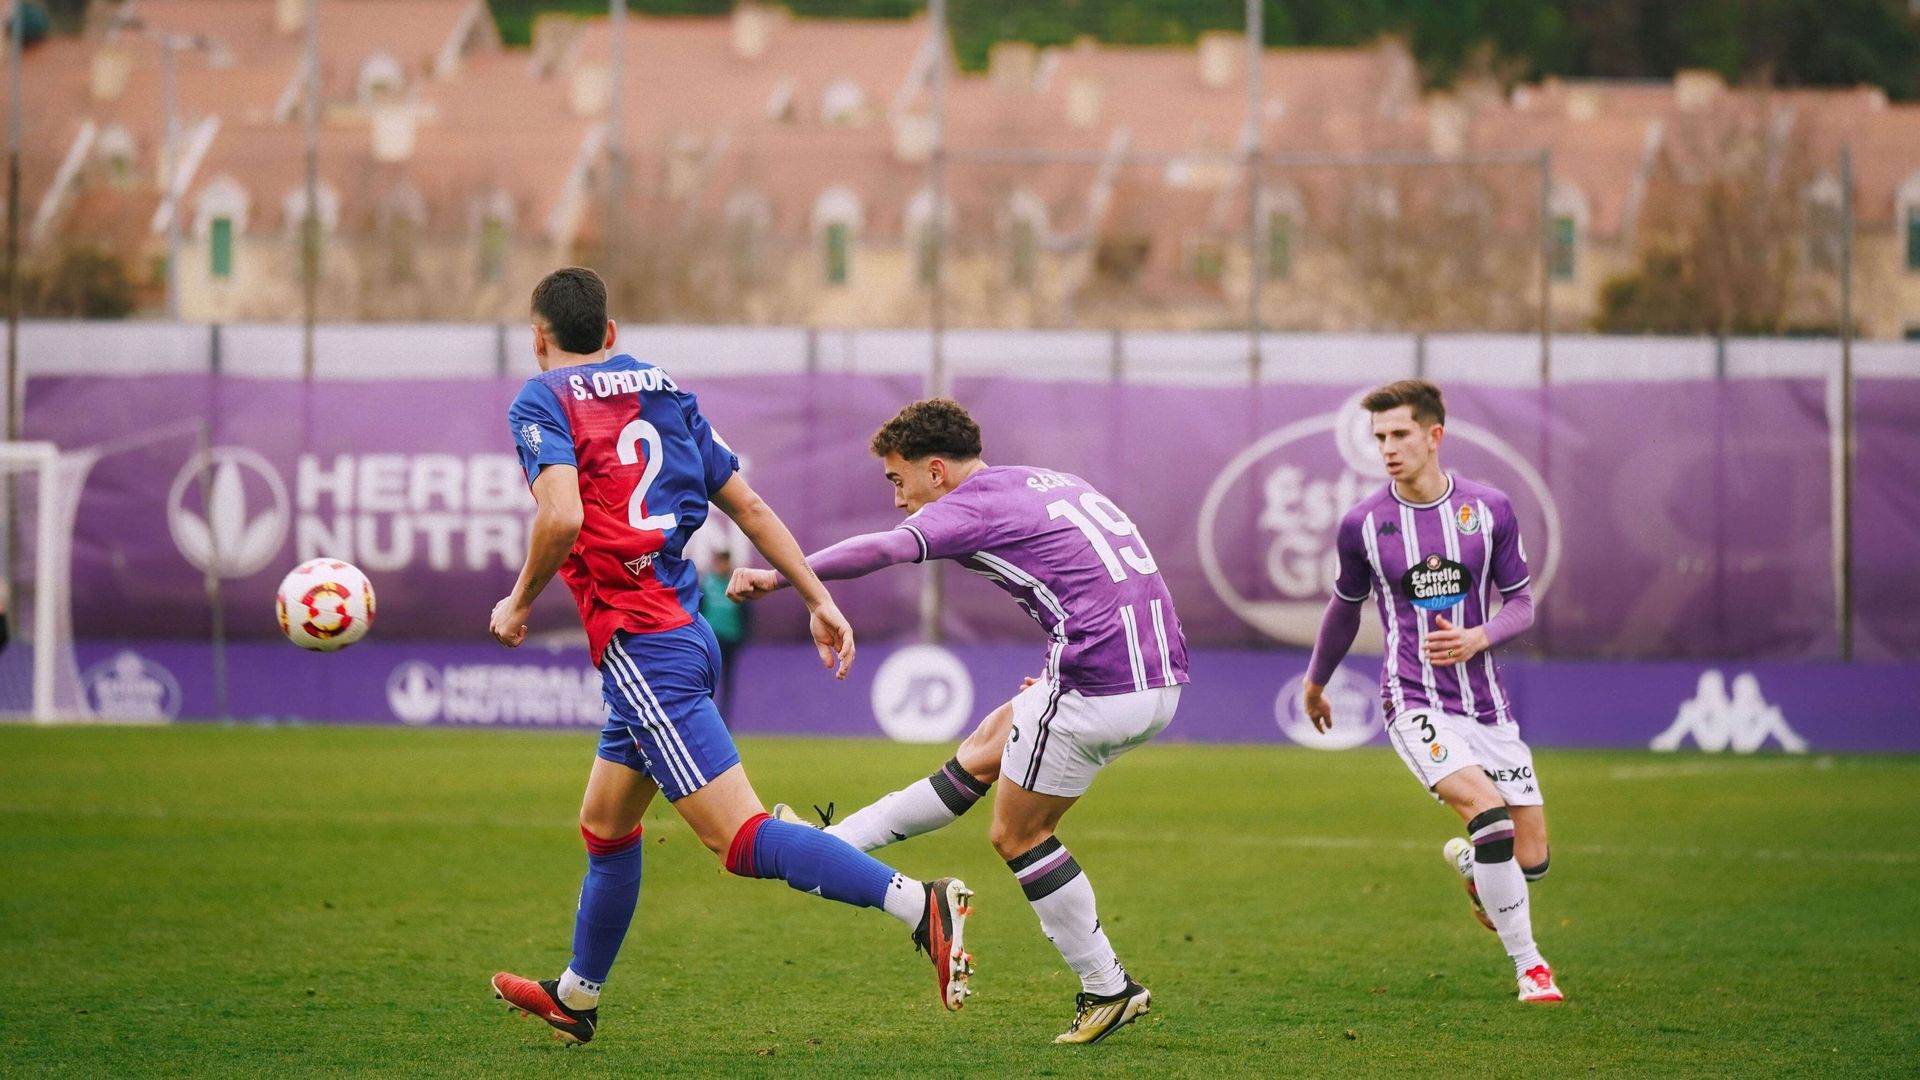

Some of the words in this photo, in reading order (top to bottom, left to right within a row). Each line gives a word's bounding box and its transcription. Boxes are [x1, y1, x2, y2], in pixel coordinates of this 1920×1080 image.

[569, 374, 593, 401] S.
[616, 419, 678, 531] 2
[1045, 492, 1158, 584] 19
[1411, 567, 1461, 586] Estrella
[1414, 581, 1461, 598] Galicia
[1412, 714, 1437, 744] 3
